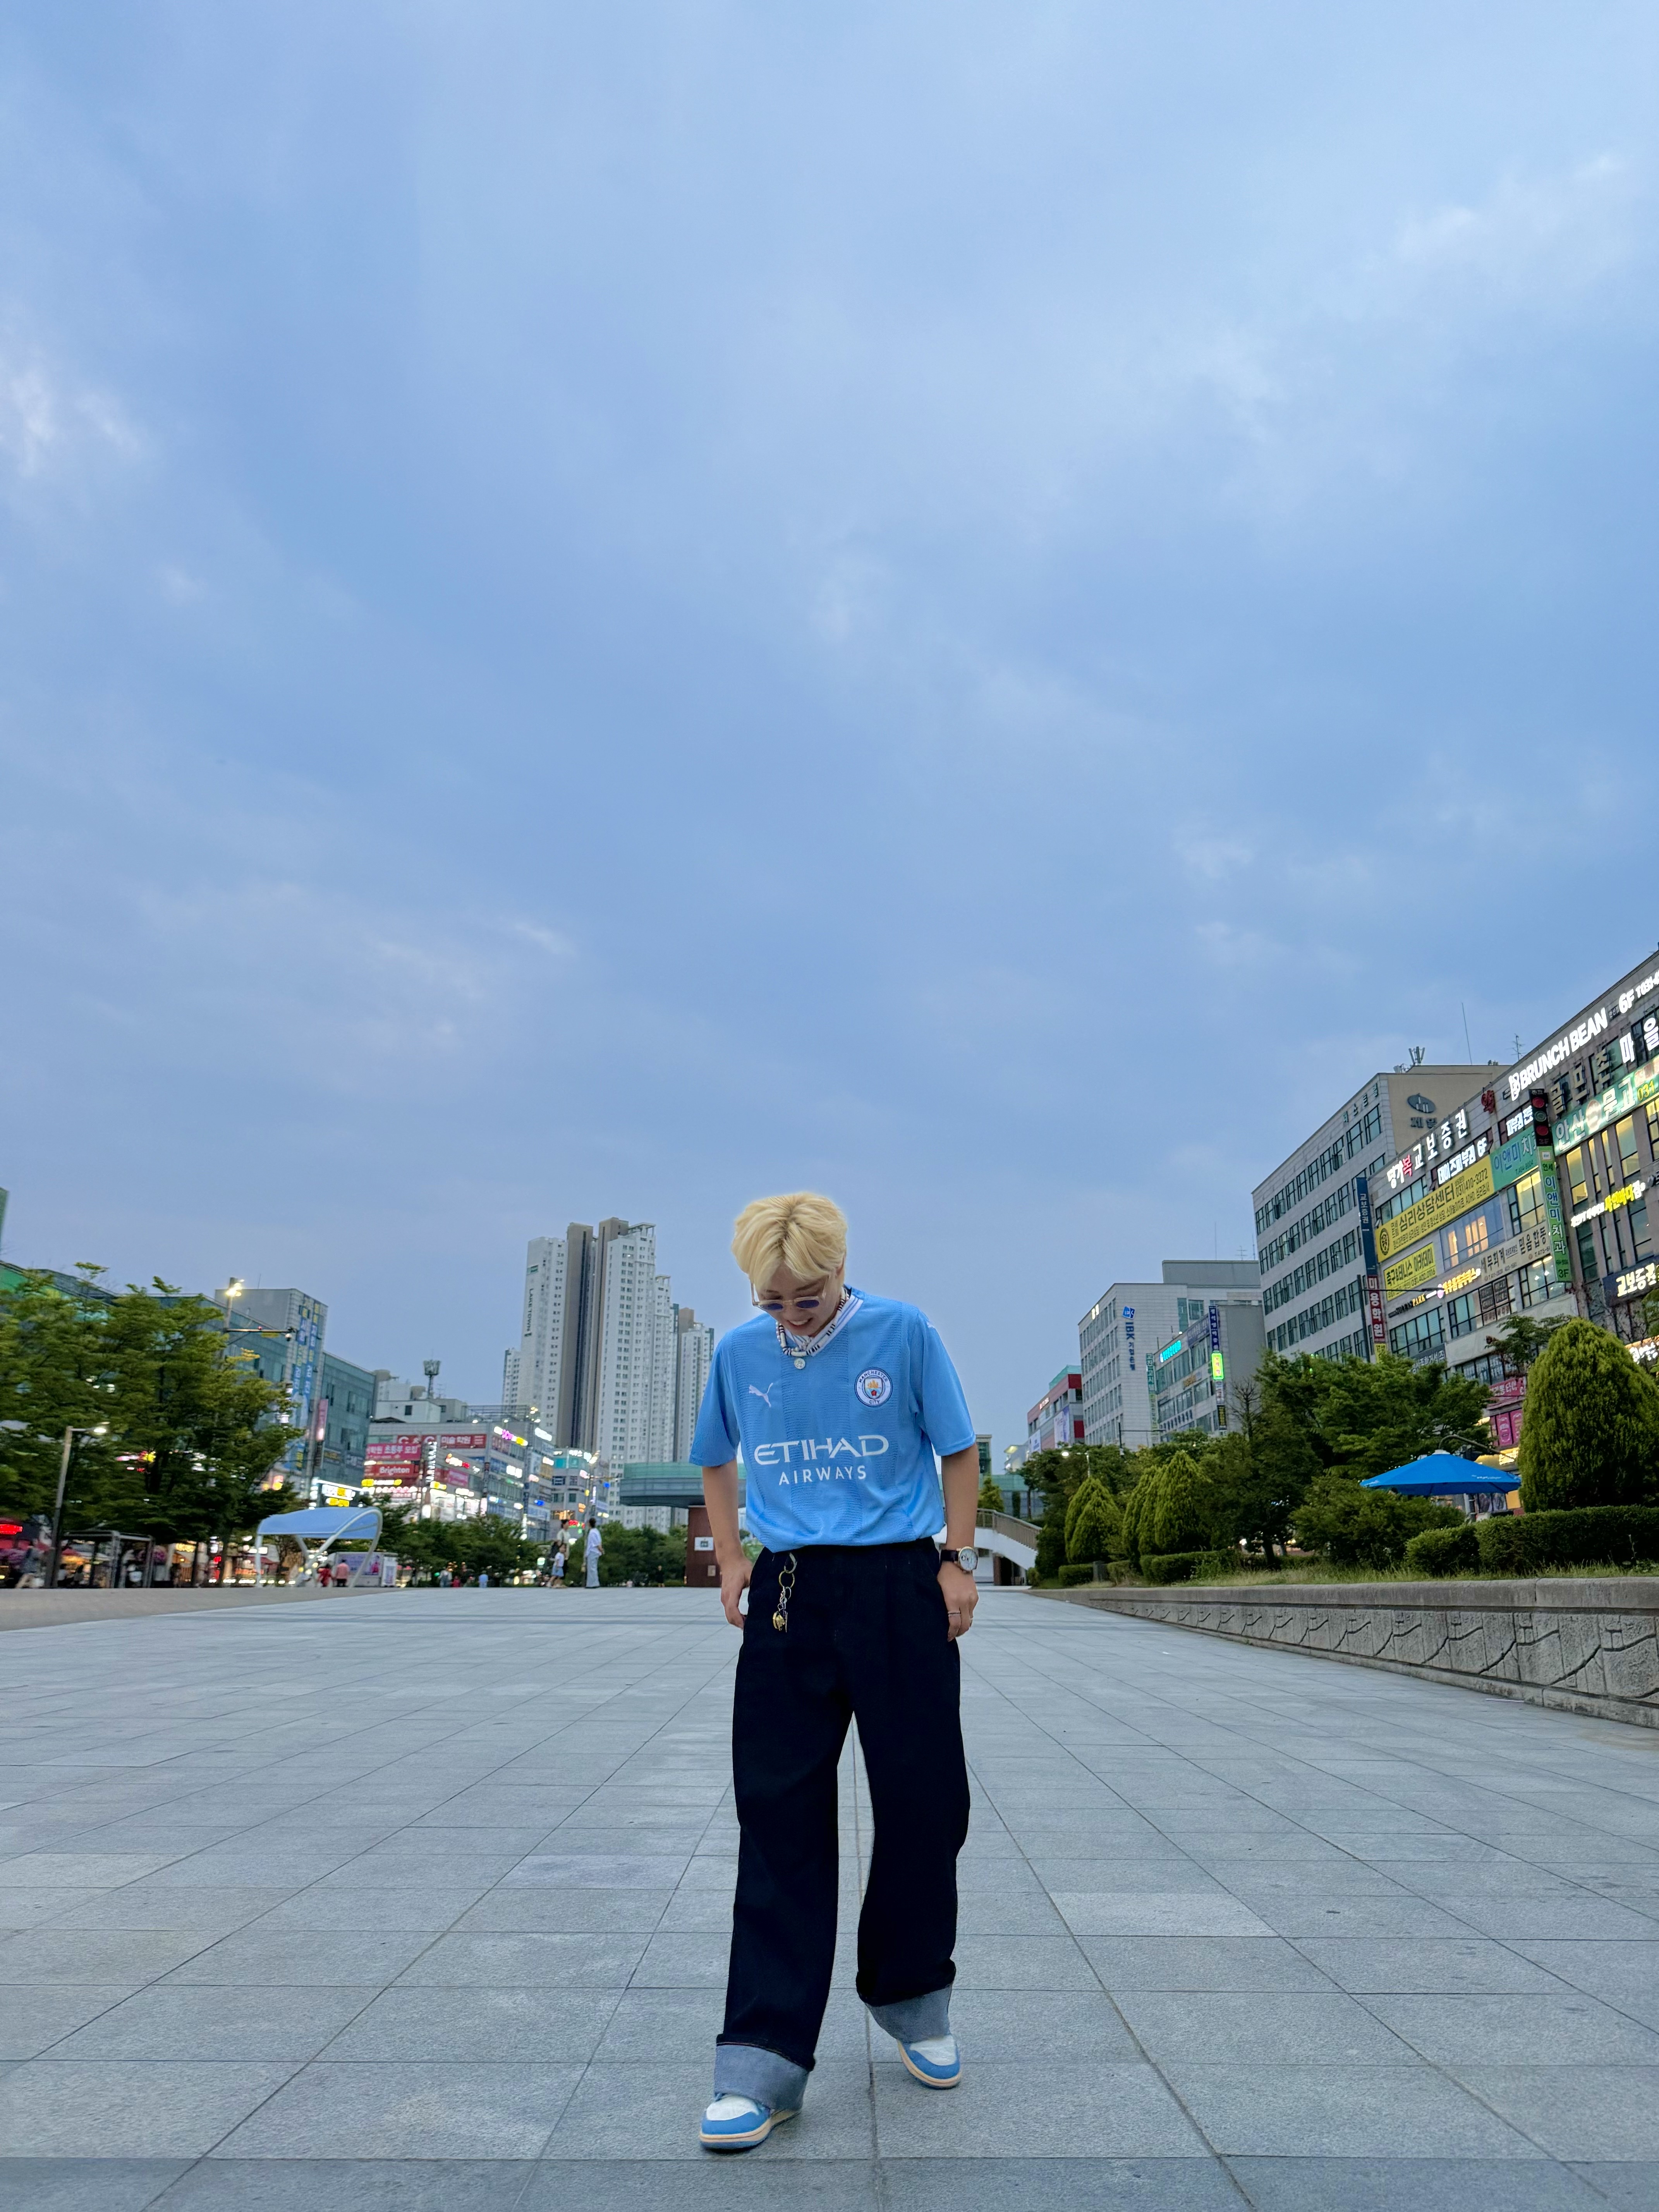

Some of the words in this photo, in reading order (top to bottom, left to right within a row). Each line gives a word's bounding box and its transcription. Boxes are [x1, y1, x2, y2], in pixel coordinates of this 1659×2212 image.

[1520, 1037, 1570, 1090] BRUNCH
[1570, 1007, 1608, 1052] BEAN
[1619, 989, 1635, 1013] 6F
[1556, 1109, 1585, 1151] 안산
[1602, 1077, 1636, 1122] 문고
[1413, 1109, 1468, 1170] 교보증권
[1455, 1168, 1488, 1197] 031)410-3272
[1360, 1193, 1369, 1224] 교보증권
[1399, 1183, 1455, 1232] 심리상담센터
[1545, 1176, 1566, 1255] 이앤미치과
[1413, 1247, 1433, 1270] 아카데미
[1481, 1247, 1506, 1273] 세무회계
[1519, 1226, 1547, 1255] 믿음합동
[1558, 1269, 1569, 1278] 3F
[1616, 1262, 1657, 1297] 교보증권
[1368, 1278, 1384, 1337] 미용학원
[1125, 1322, 1135, 1340] IBK
[859, 1370, 888, 1383] MANCHESTER
[754, 1434, 889, 1465] ETIHAD
[380, 1466, 410, 1476] Brighton
[778, 1465, 866, 1486] AIRWAYS
